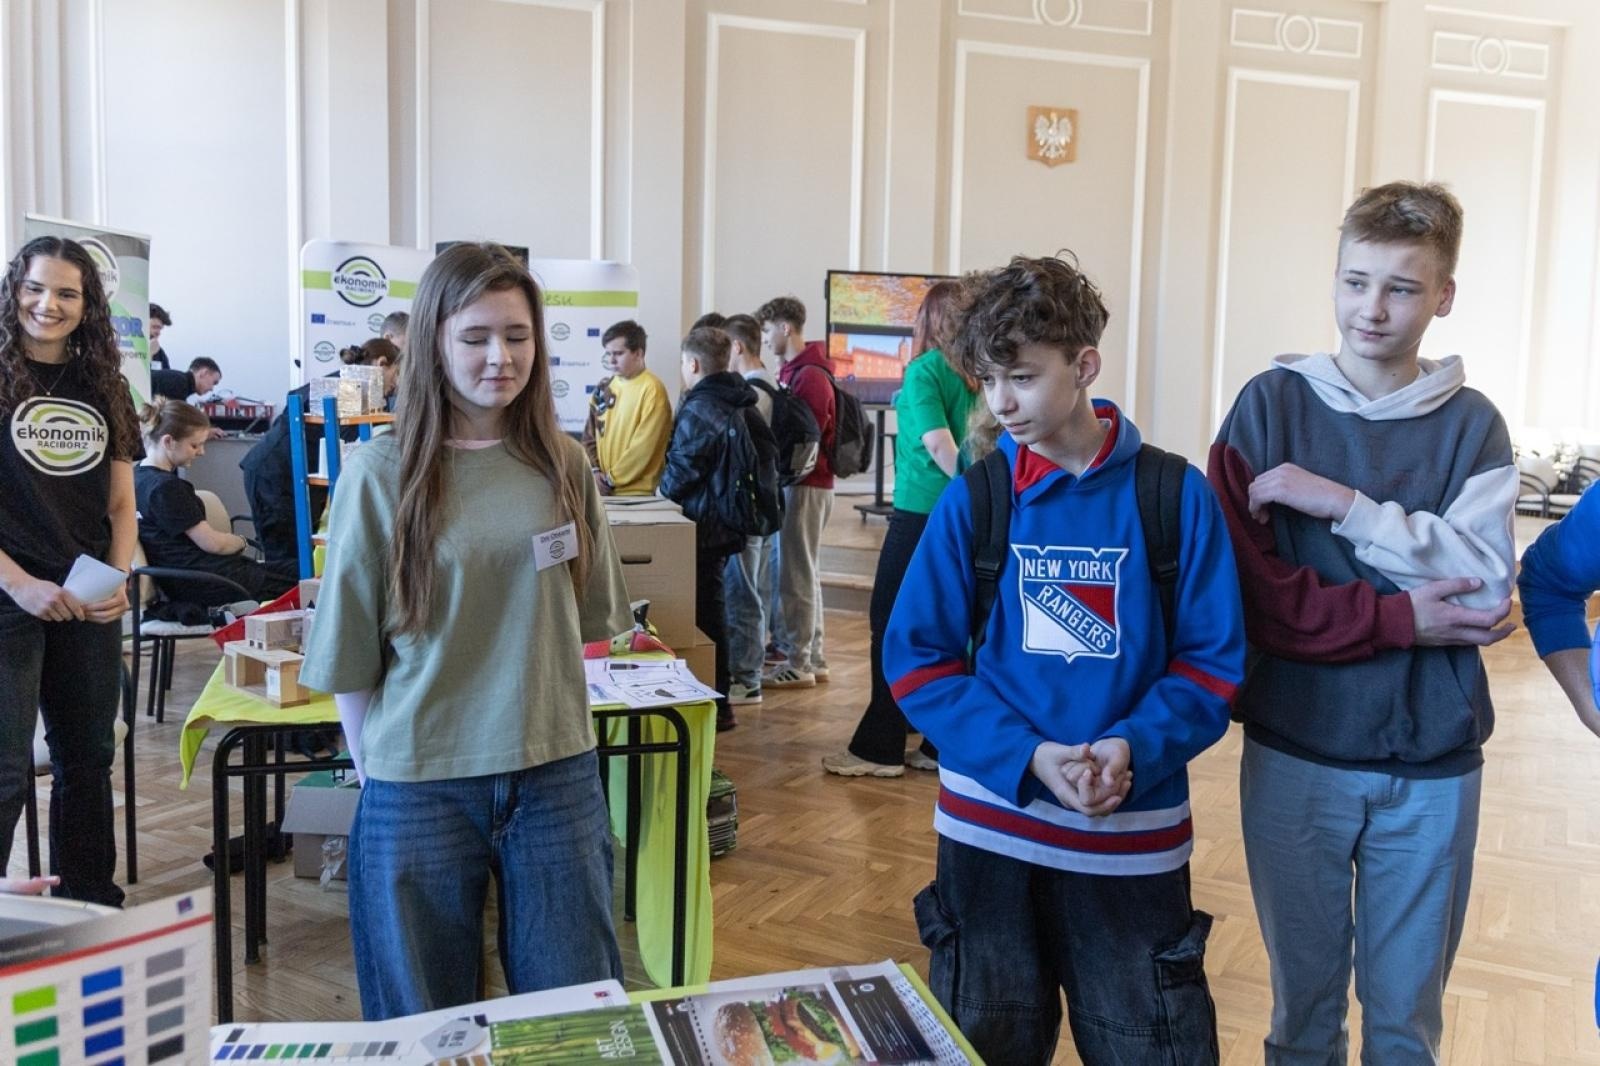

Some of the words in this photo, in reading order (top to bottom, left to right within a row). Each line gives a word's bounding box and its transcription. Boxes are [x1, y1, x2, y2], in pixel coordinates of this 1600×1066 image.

[16, 424, 105, 442] ekonomik
[38, 440, 89, 449] RACIBORZ
[1024, 558, 1062, 578] NEW
[1068, 559, 1113, 580] YORK
[1037, 585, 1111, 649] RANGERS
